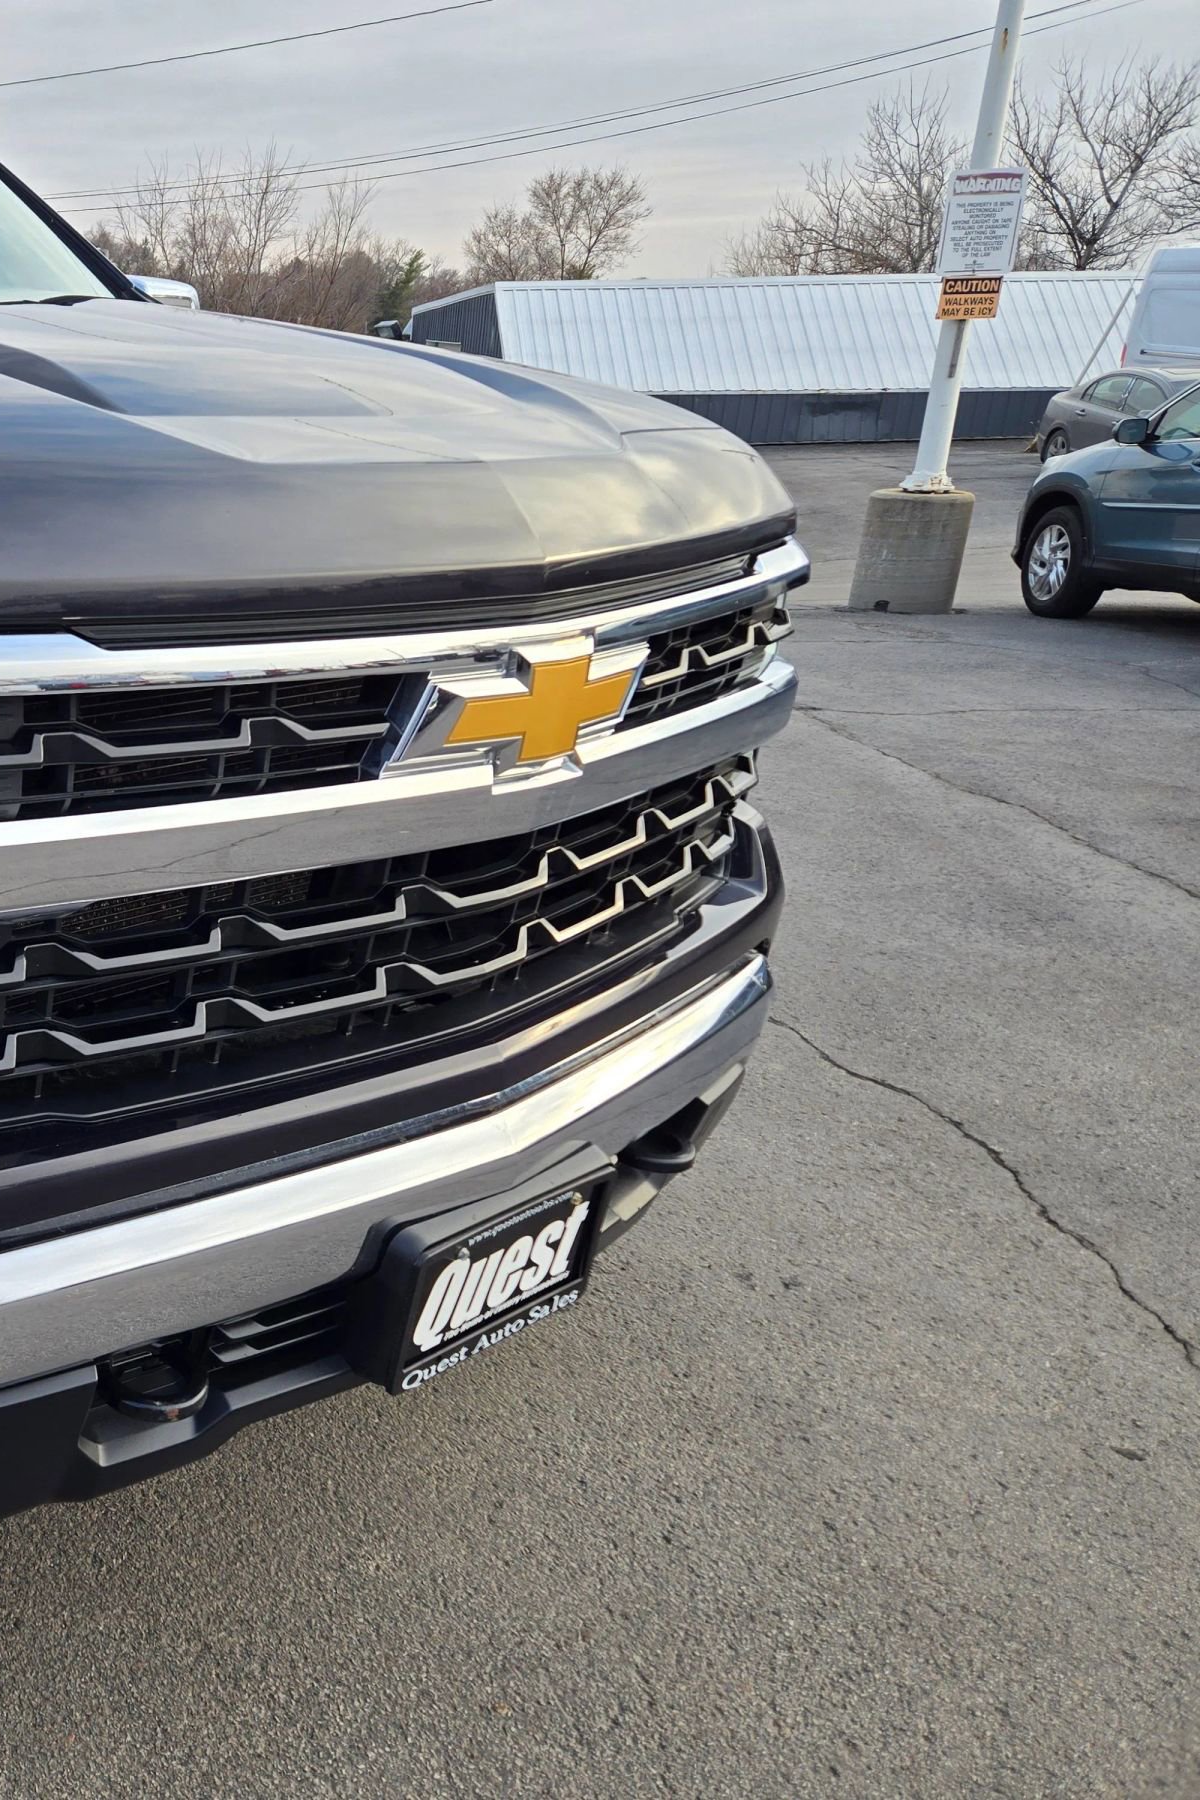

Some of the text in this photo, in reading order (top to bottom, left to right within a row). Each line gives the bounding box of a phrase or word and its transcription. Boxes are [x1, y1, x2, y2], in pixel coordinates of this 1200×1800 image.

[954, 177, 1021, 193] WARNING
[945, 280, 999, 293] CAUTION
[945, 297, 994, 306] WALKWAYS
[941, 307, 993, 316] MAY BE ICY
[412, 1201, 590, 1353] Quest
[401, 1346, 468, 1391] Quest
[471, 1317, 525, 1355] Auto
[527, 1289, 579, 1325] Sales
